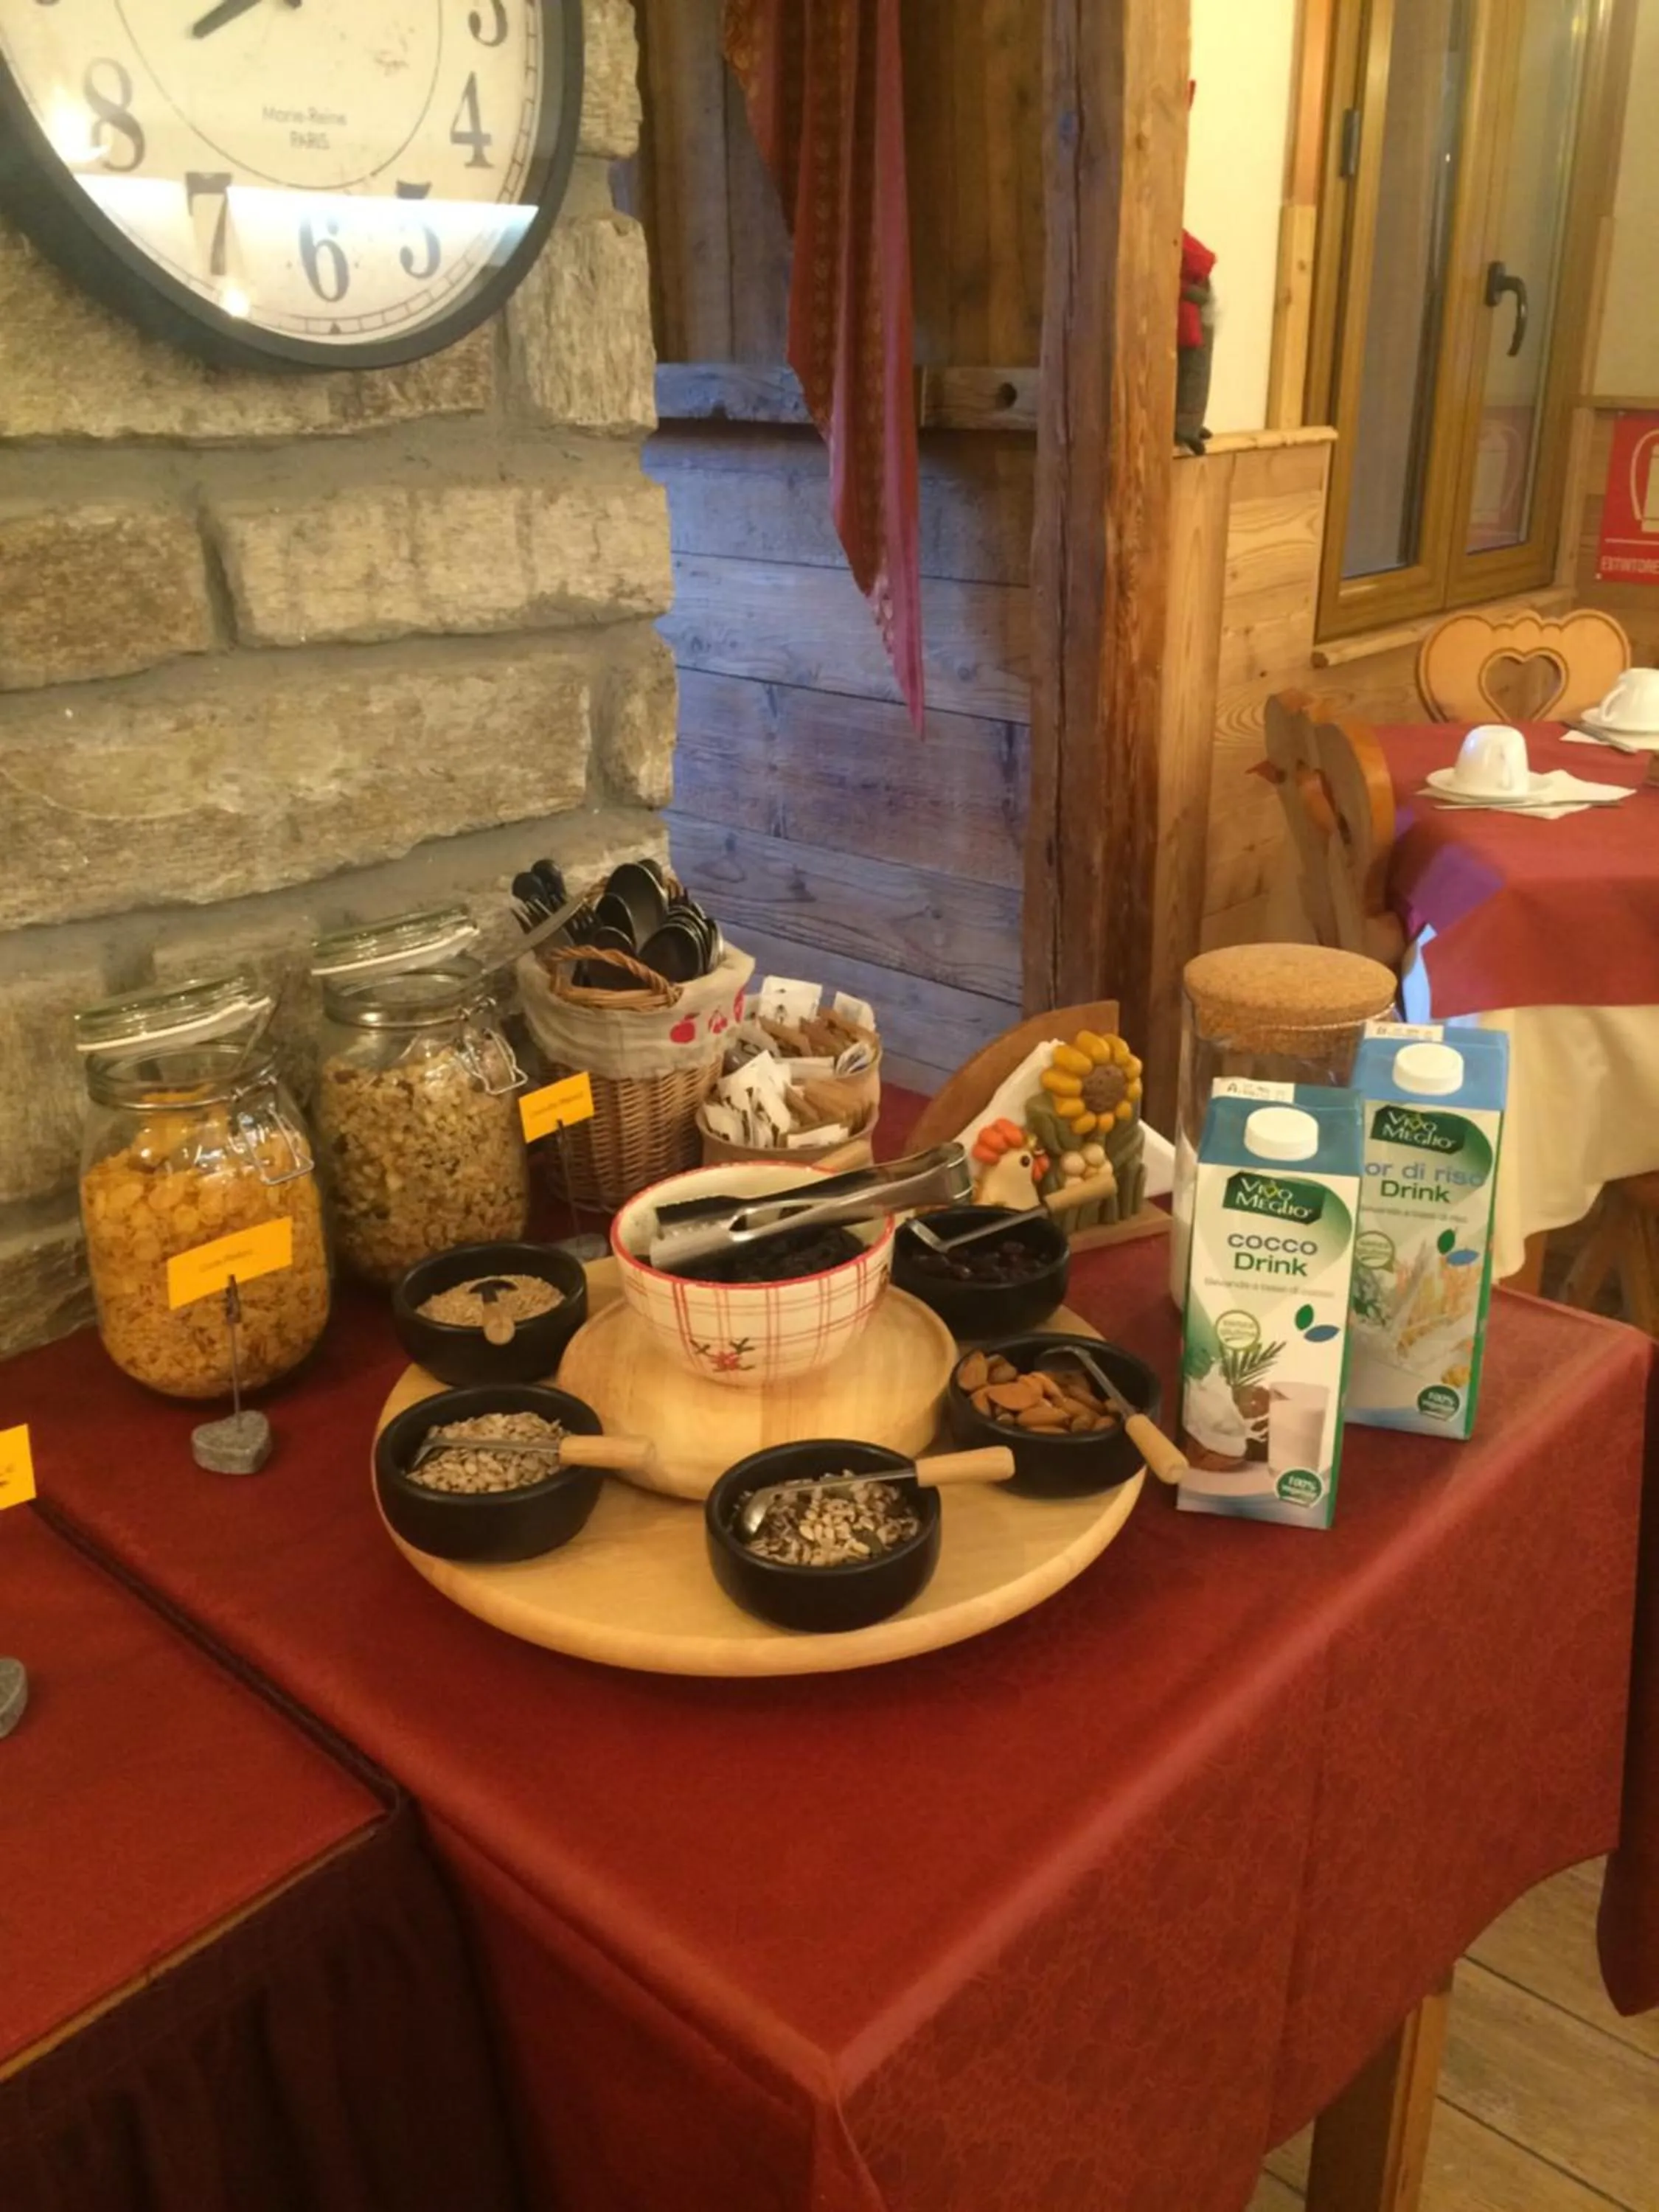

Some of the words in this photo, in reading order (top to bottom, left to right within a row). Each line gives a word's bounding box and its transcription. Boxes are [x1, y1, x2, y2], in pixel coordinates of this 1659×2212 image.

[83, 58, 145, 173] 8
[450, 72, 494, 169] 4
[185, 172, 232, 276] 7
[396, 180, 440, 279] 5
[299, 214, 349, 303] 6
[1380, 1180, 1450, 1204] Drink
[1402, 1163, 1425, 1180] di
[1435, 1166, 1485, 1189] riso
[1228, 1233, 1318, 1256] cocco
[1234, 1251, 1307, 1277] Drink
[1288, 1475, 1317, 1491] 100%
